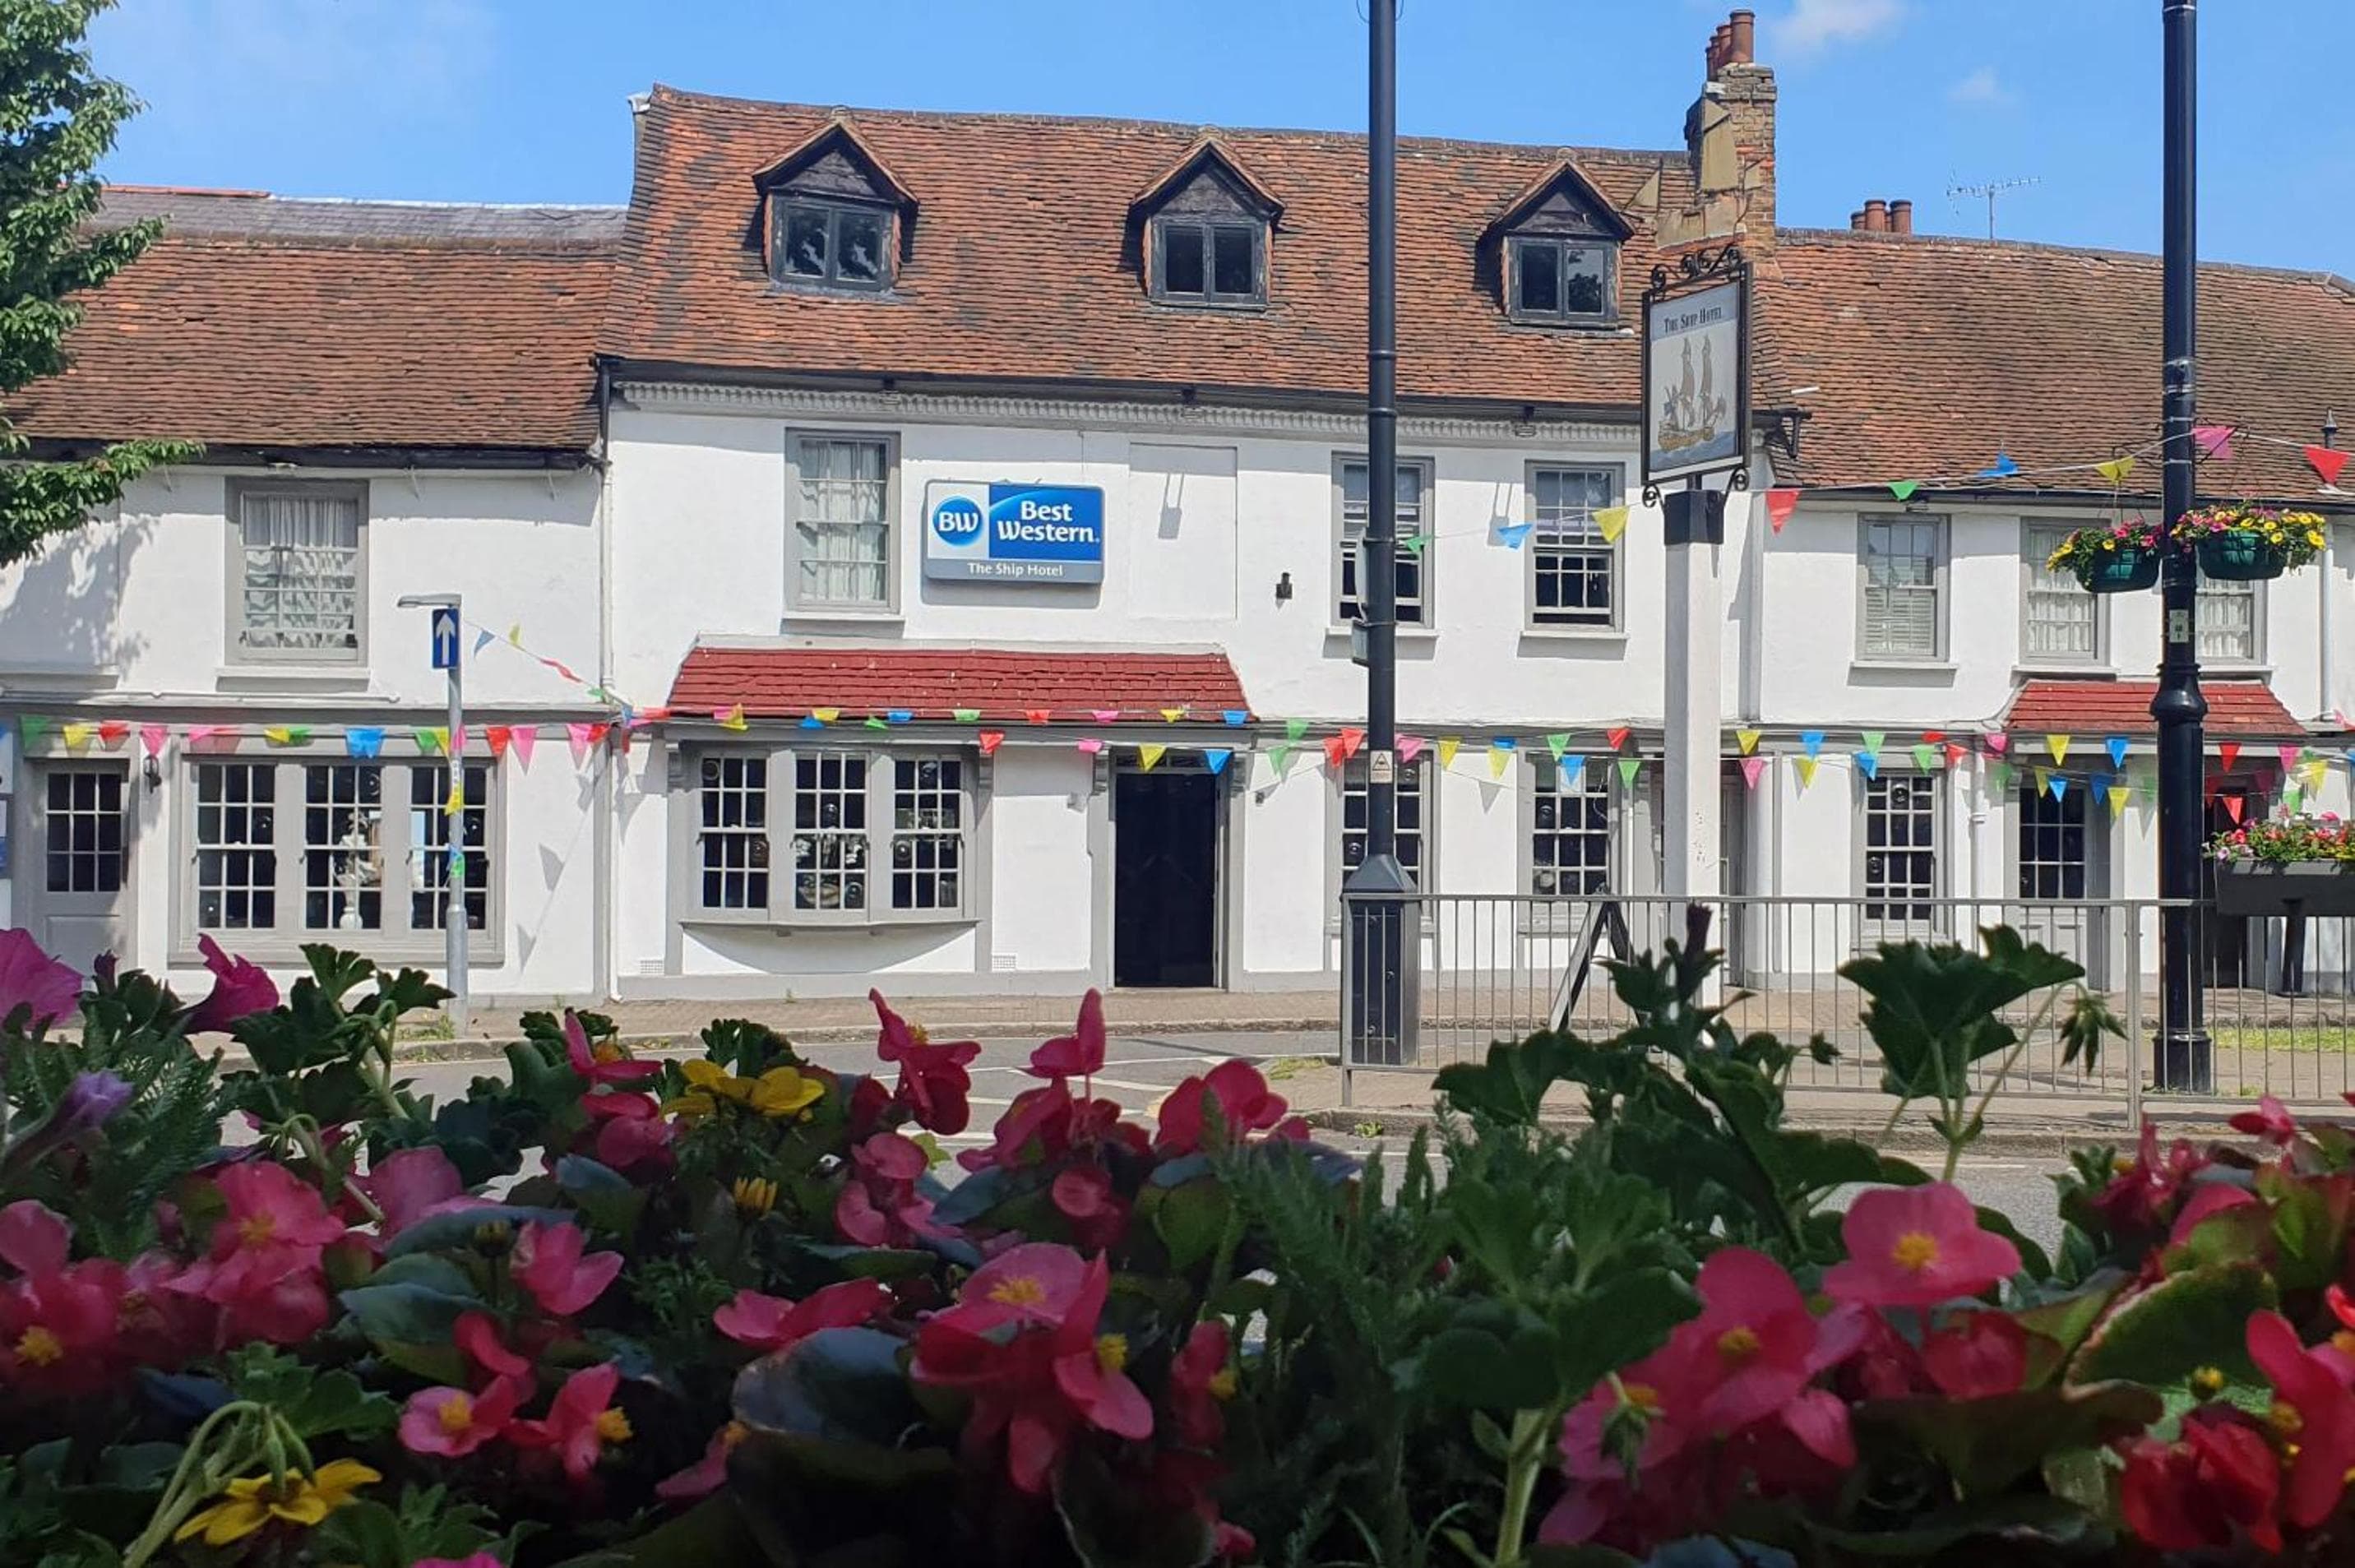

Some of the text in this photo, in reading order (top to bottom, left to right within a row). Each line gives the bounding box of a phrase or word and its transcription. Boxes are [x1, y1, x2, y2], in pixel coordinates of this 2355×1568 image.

[1020, 500, 1072, 521] Best
[938, 511, 979, 532] BW
[997, 520, 1094, 543] Western
[967, 562, 1063, 578] The Ship Hotel
